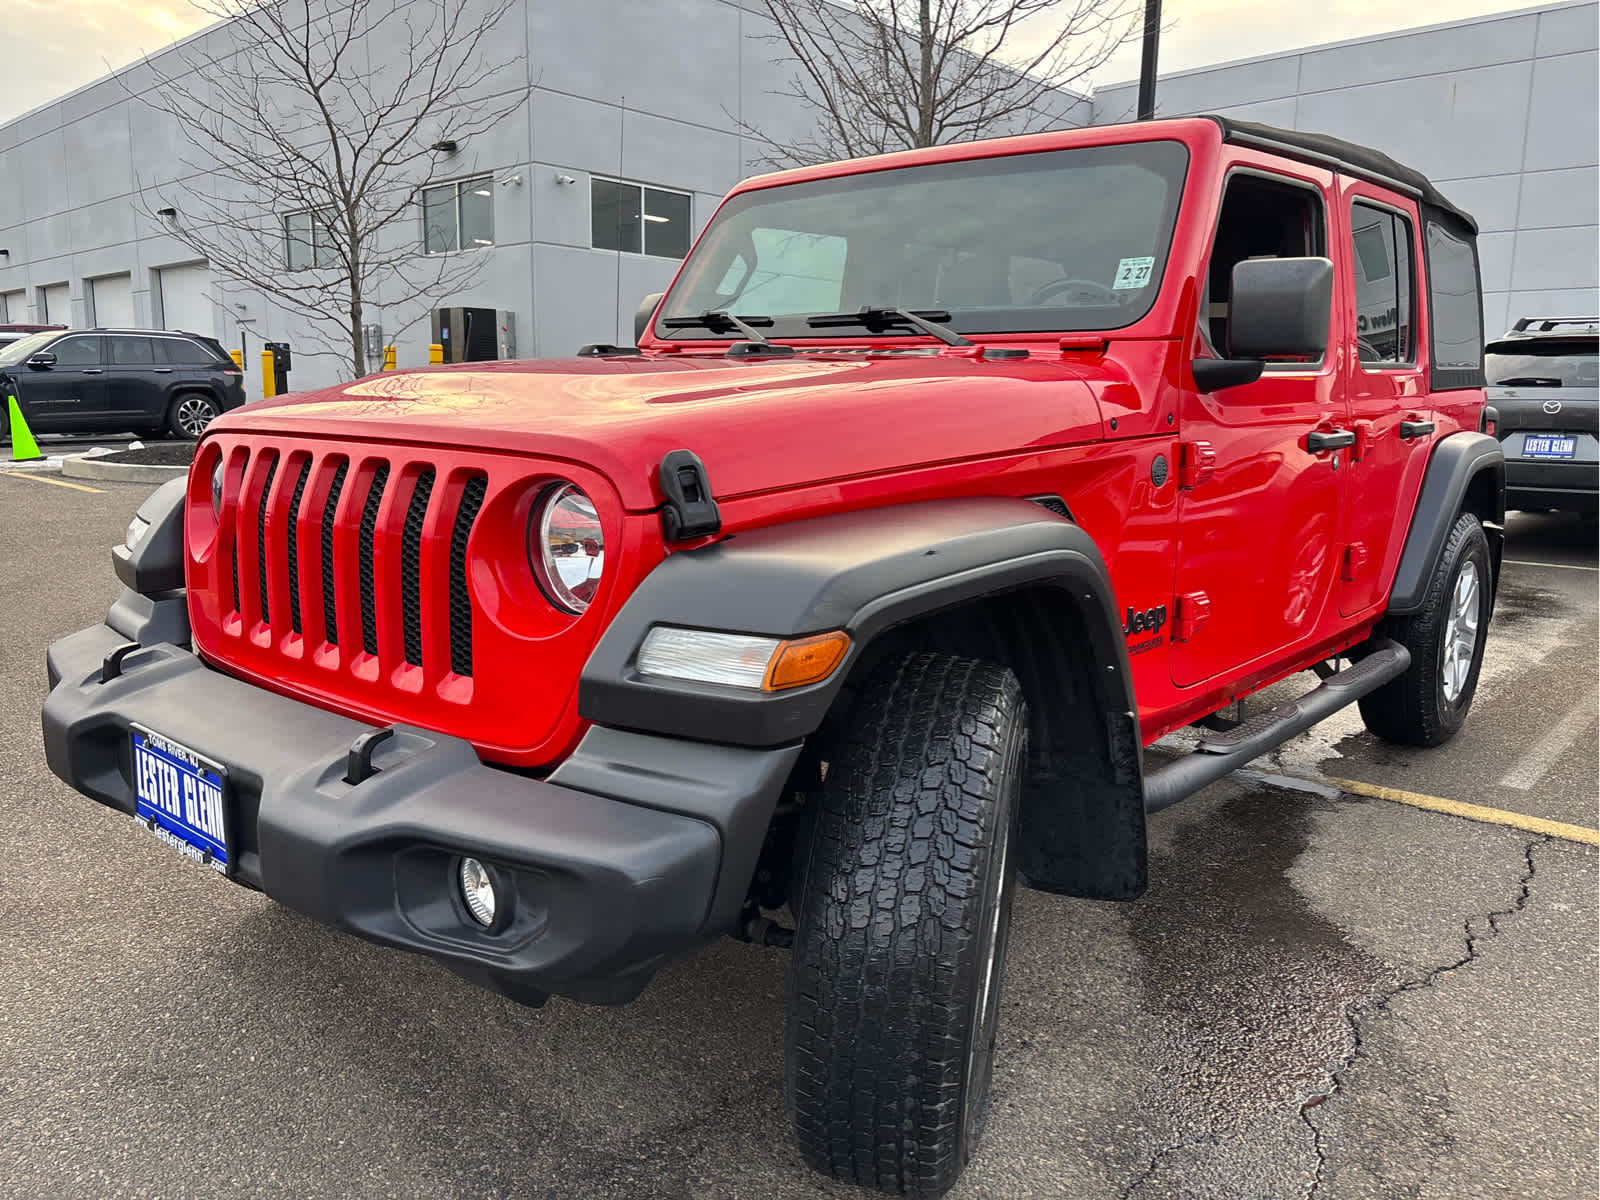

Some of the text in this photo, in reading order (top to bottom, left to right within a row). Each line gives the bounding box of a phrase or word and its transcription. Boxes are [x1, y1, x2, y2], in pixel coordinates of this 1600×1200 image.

[1122, 266, 1151, 280] 2 27
[1525, 439, 1574, 452] LESTER GLENN
[1120, 604, 1166, 637] Jeep
[135, 748, 226, 844] LESTER GLENN
